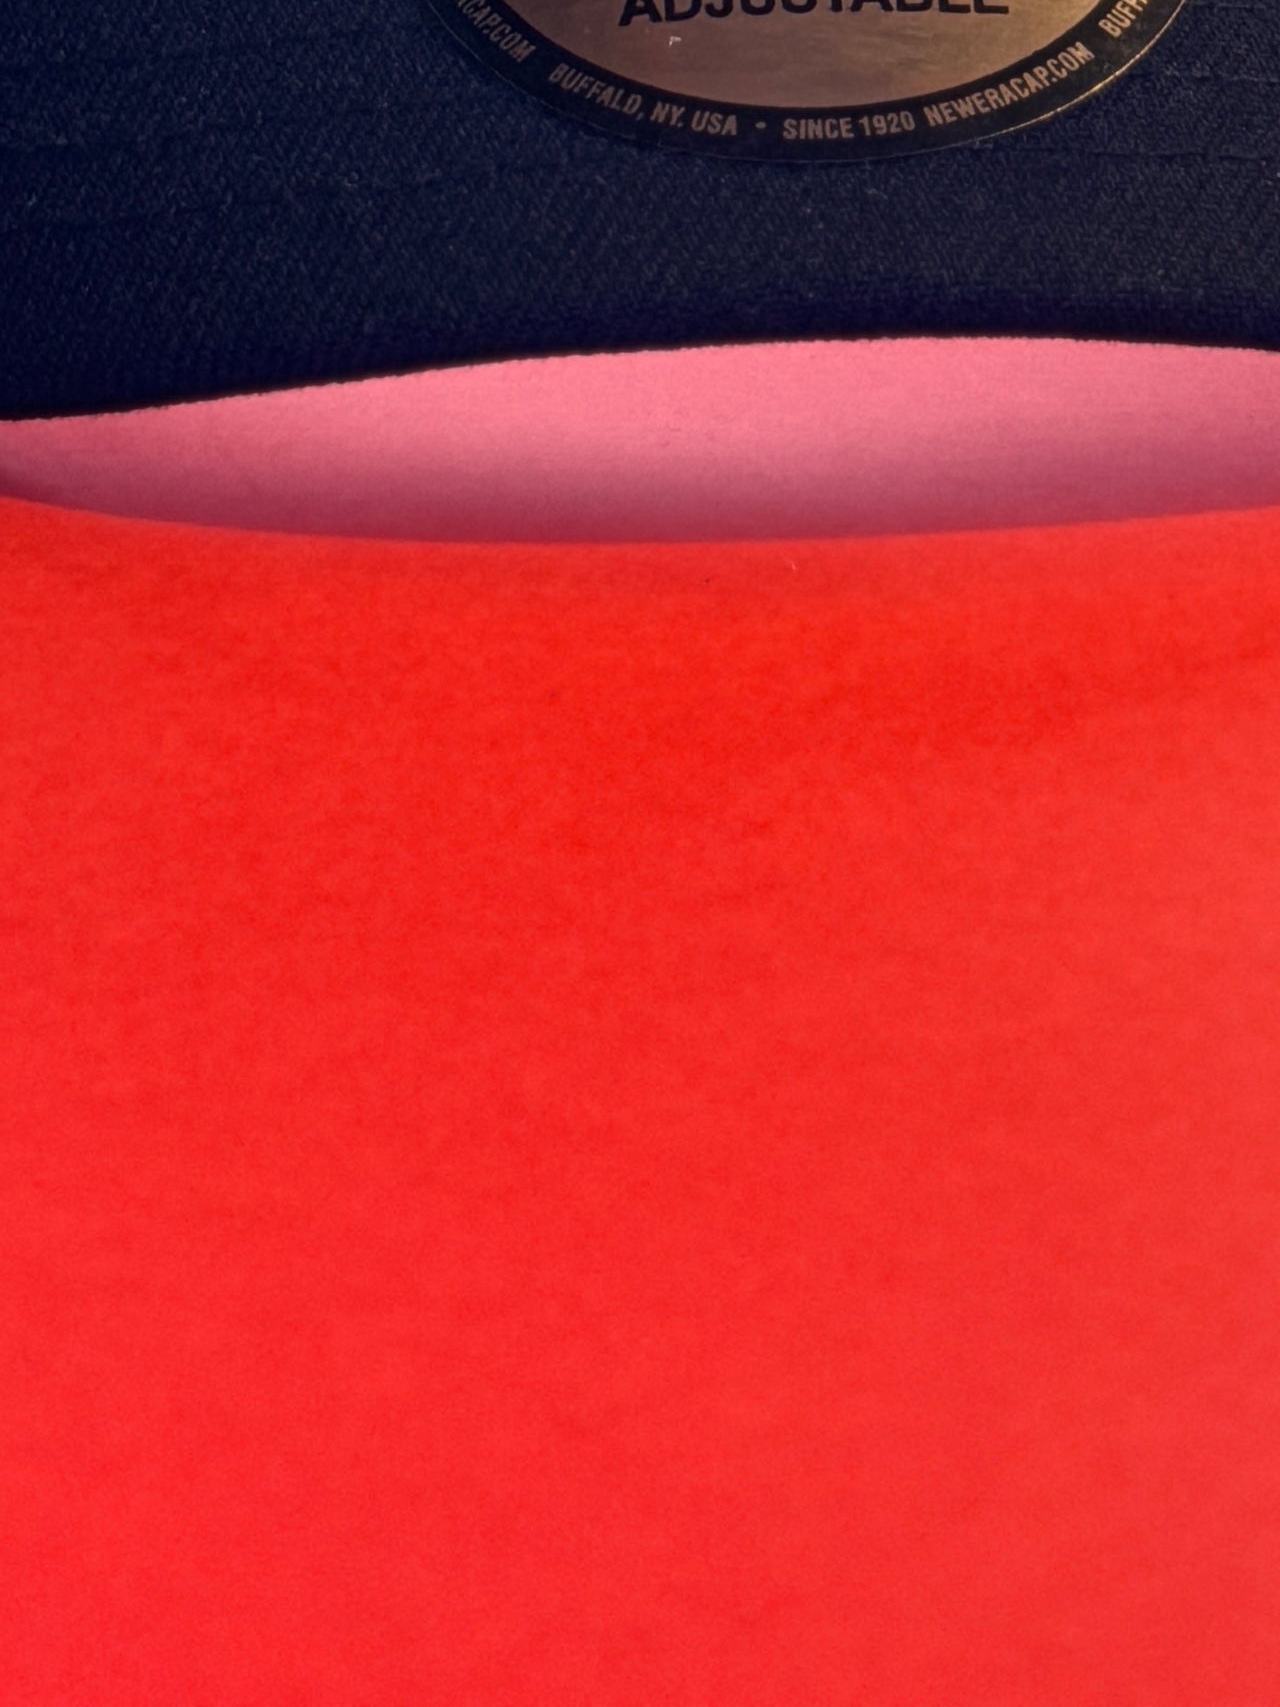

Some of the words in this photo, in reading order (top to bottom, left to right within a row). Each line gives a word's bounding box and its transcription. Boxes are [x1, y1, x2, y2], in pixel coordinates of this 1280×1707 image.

[690, 110, 738, 137] USA
[782, 116, 855, 140] SINCE
[858, 110, 916, 138] 1920
[923, 40, 1096, 129] NEWERACAP.COM
